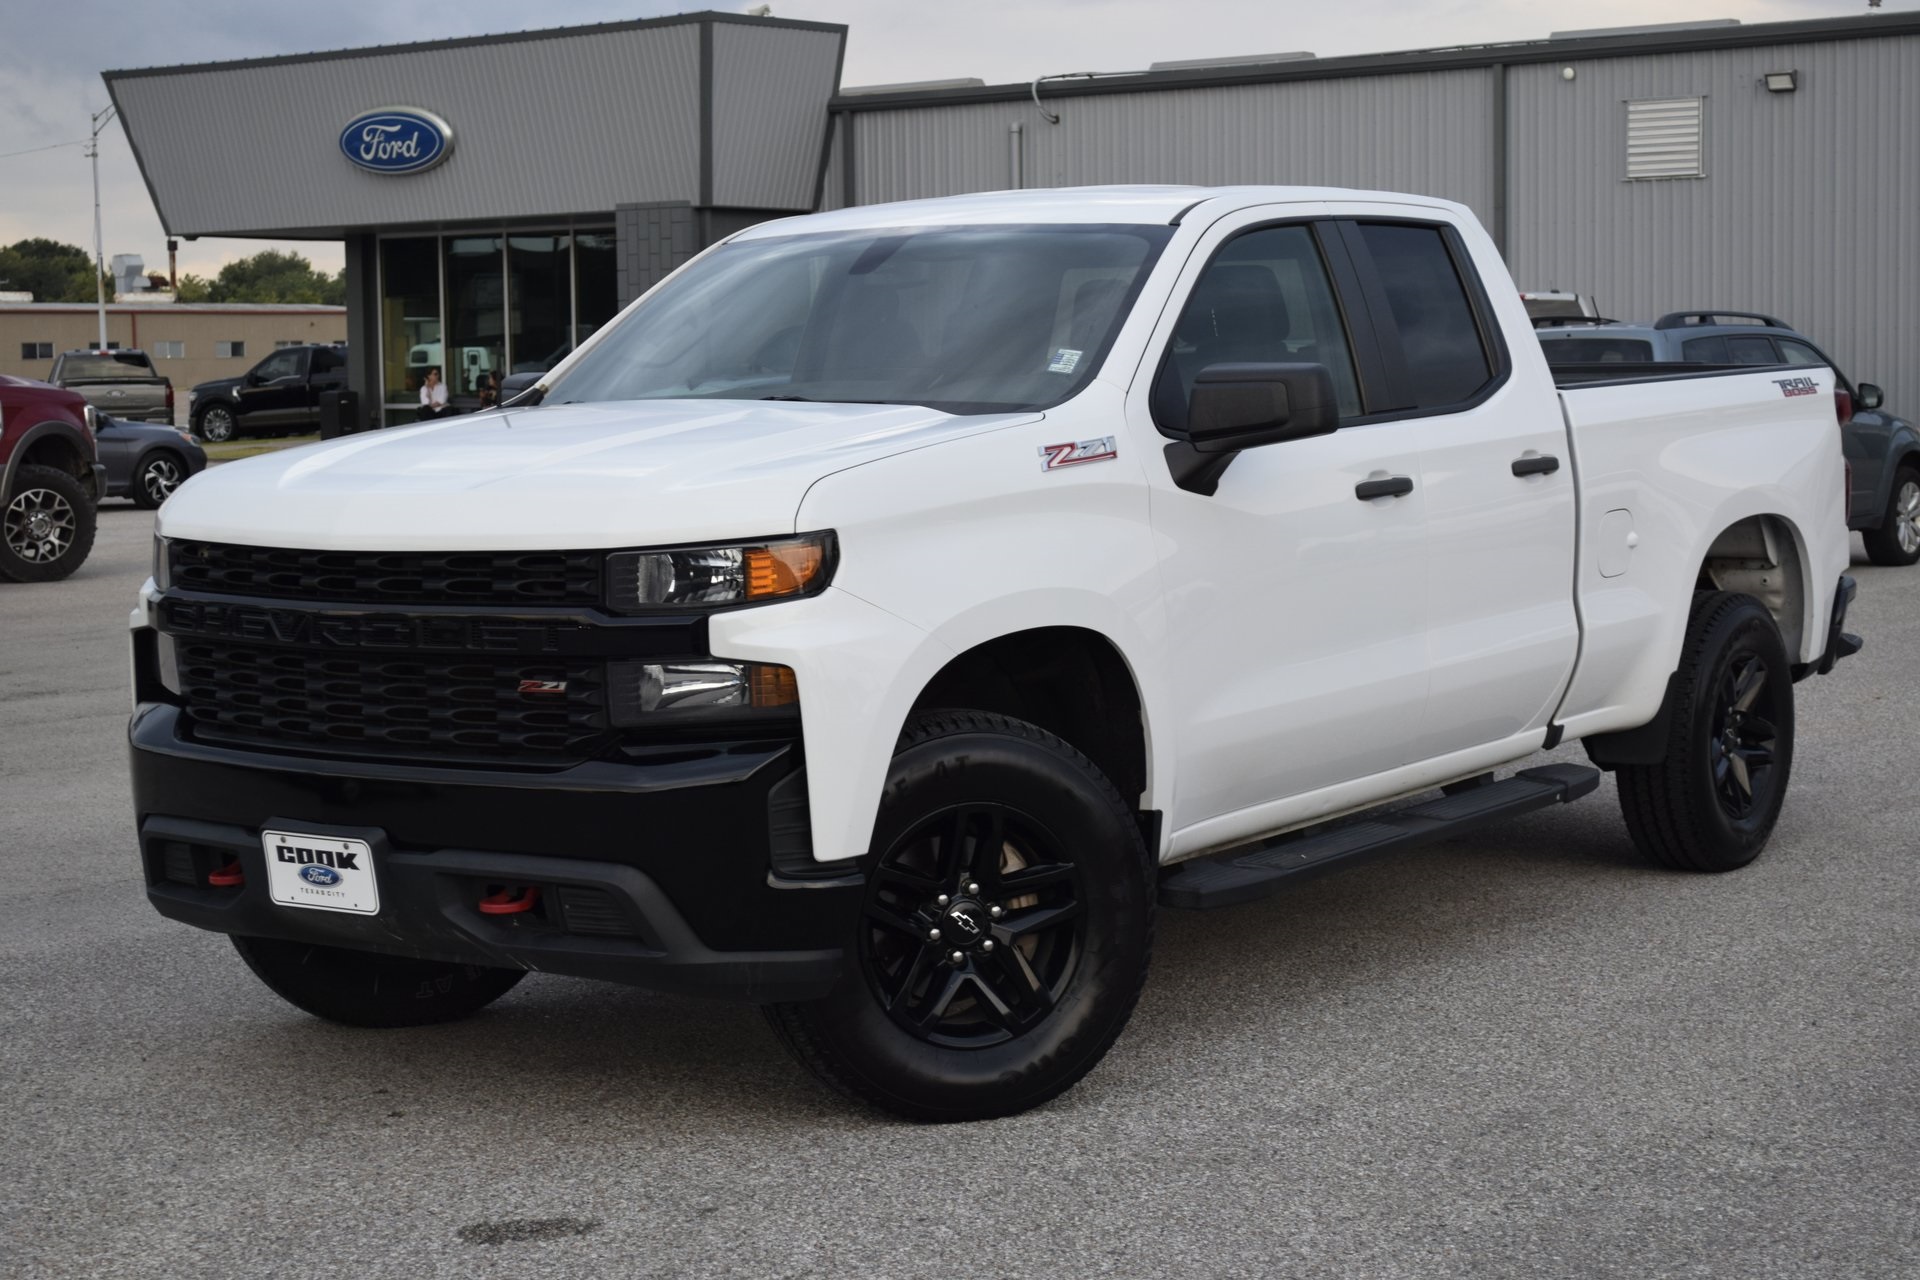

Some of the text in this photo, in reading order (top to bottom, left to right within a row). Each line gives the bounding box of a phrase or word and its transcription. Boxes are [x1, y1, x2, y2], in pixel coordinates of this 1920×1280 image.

[360, 125, 420, 160] Ford
[1772, 377, 1819, 389] TRAIL
[1783, 386, 1818, 397] BOSS
[1037, 435, 1118, 472] Z71
[167, 599, 581, 651] CHEVROLET
[517, 679, 568, 693] Z71
[275, 845, 361, 871] COOK
[307, 867, 333, 884] Ford
